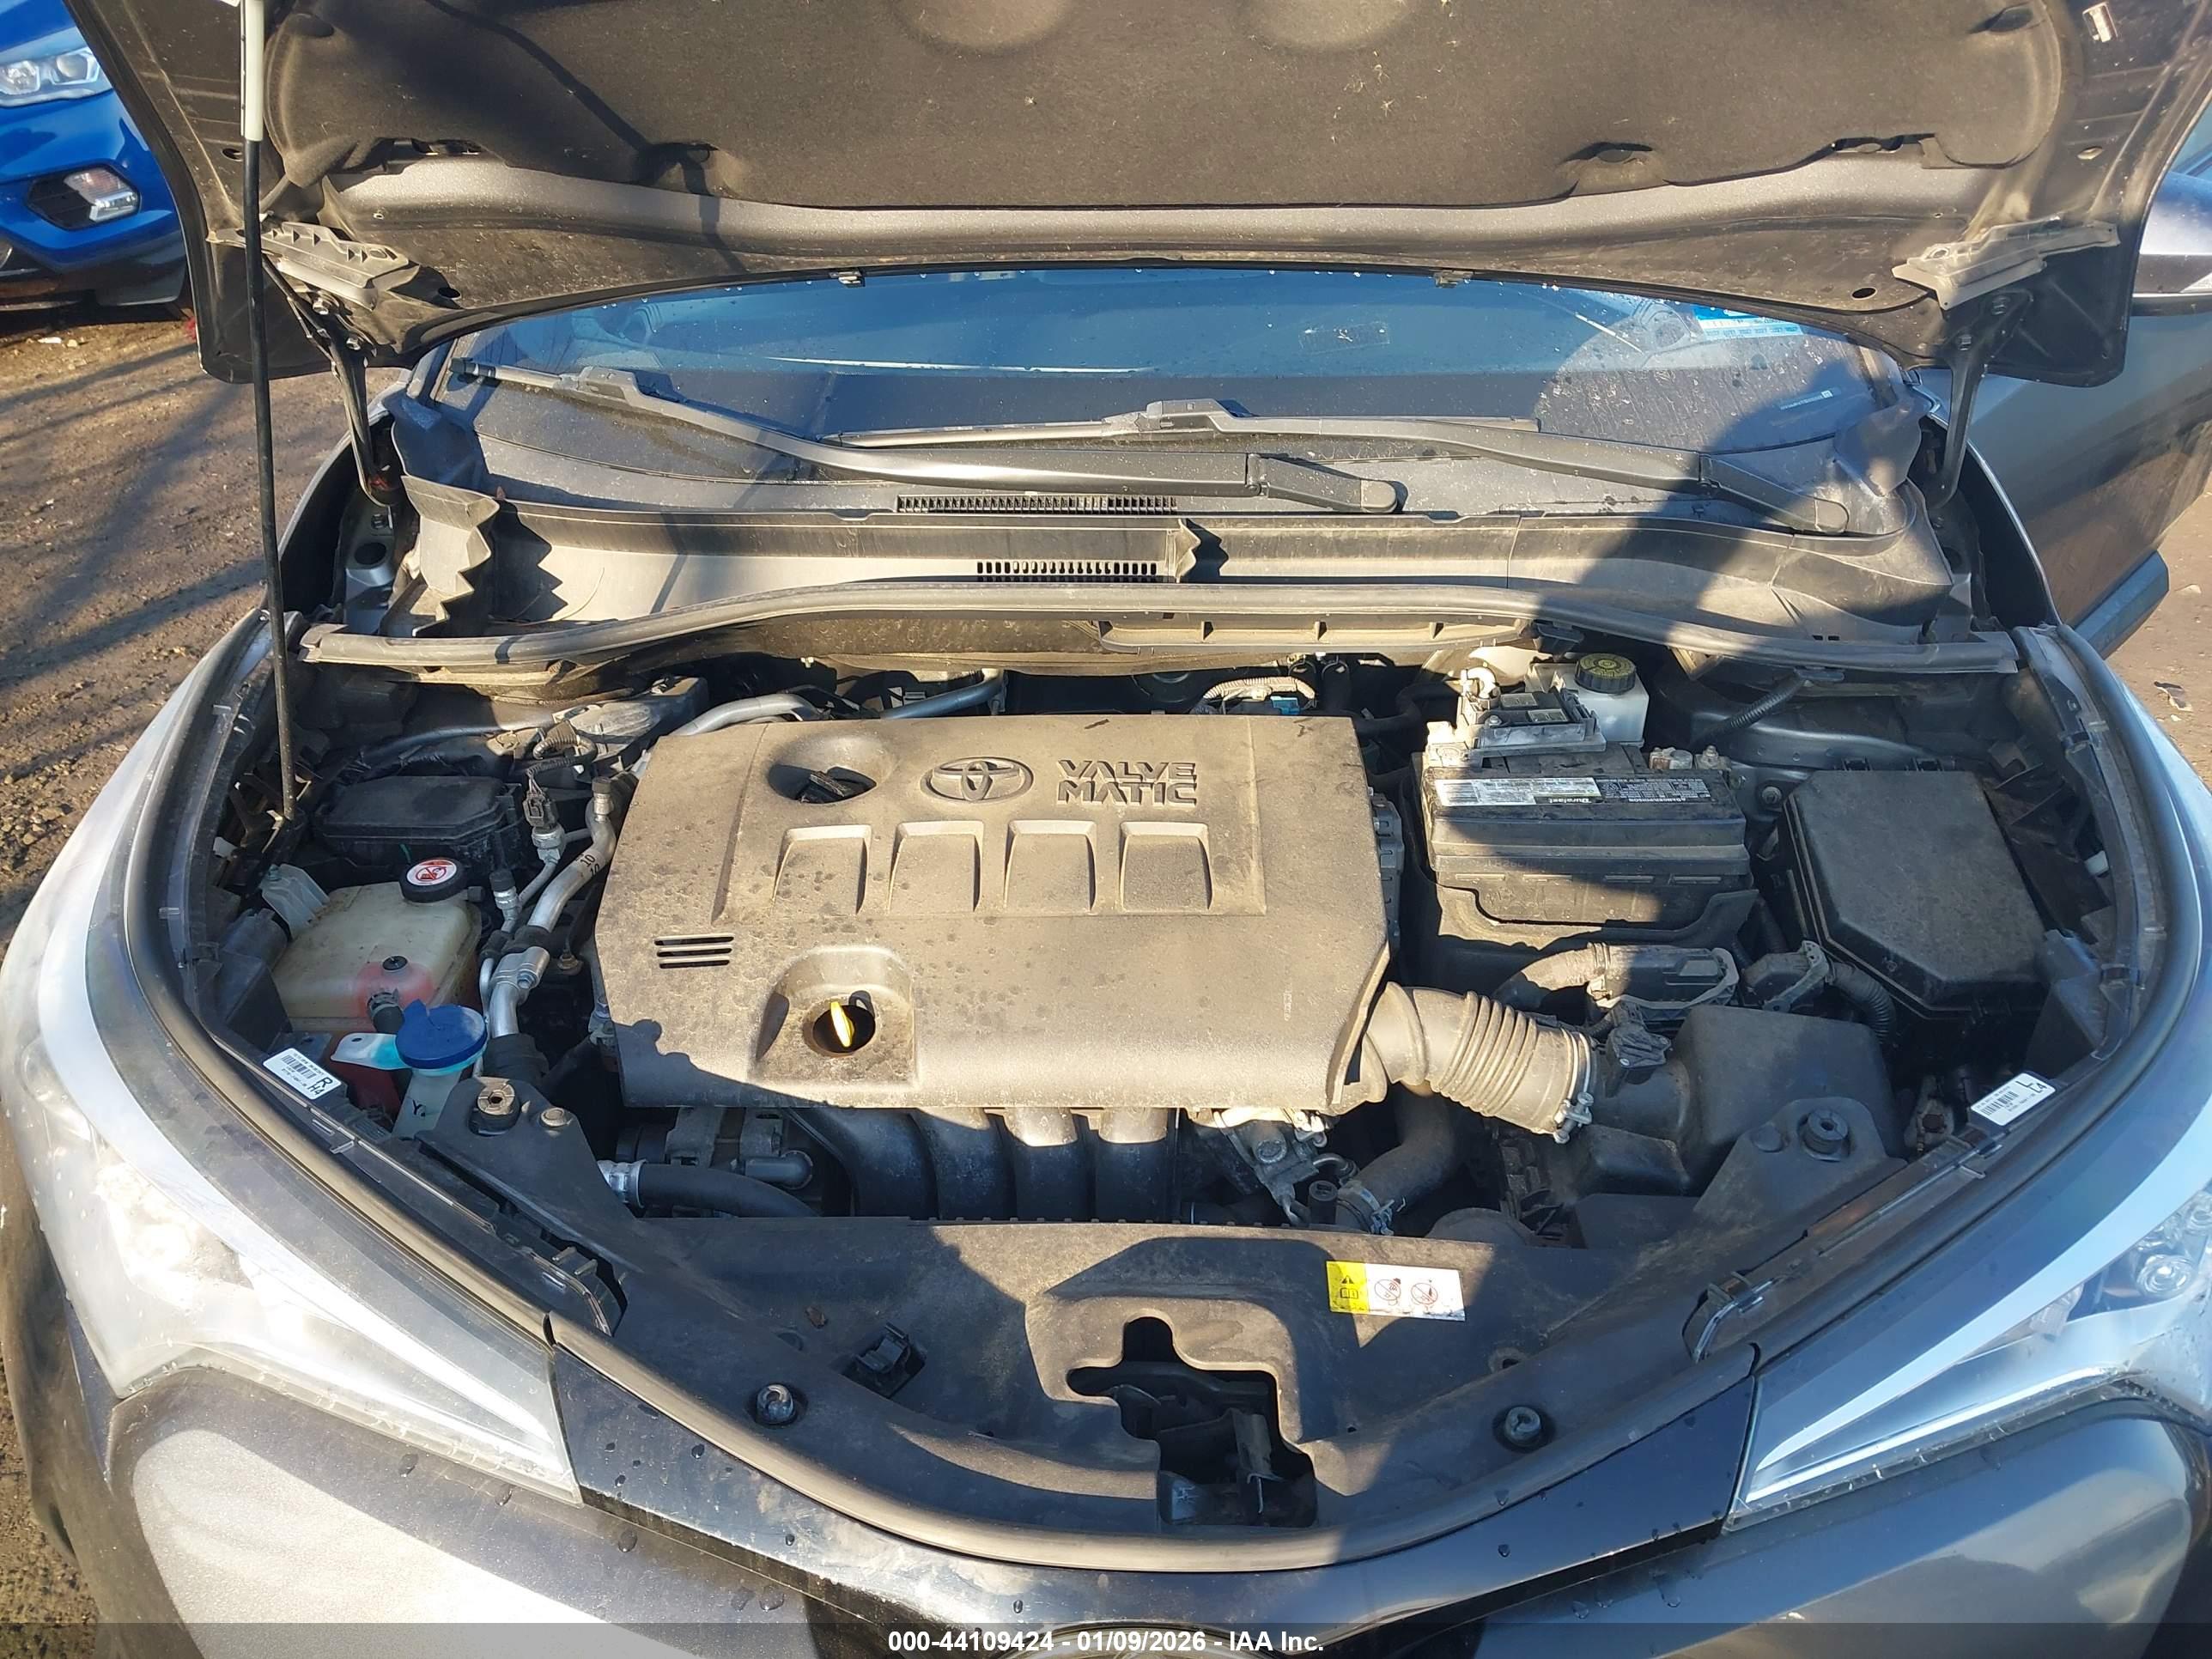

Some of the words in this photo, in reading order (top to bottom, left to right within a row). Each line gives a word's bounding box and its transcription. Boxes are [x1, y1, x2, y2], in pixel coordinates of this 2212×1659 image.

[1057, 759, 1197, 782] VALVE
[1057, 780, 1198, 805] MATIC
[307, 1084, 325, 1096] H4
[317, 1077, 333, 1089] R
